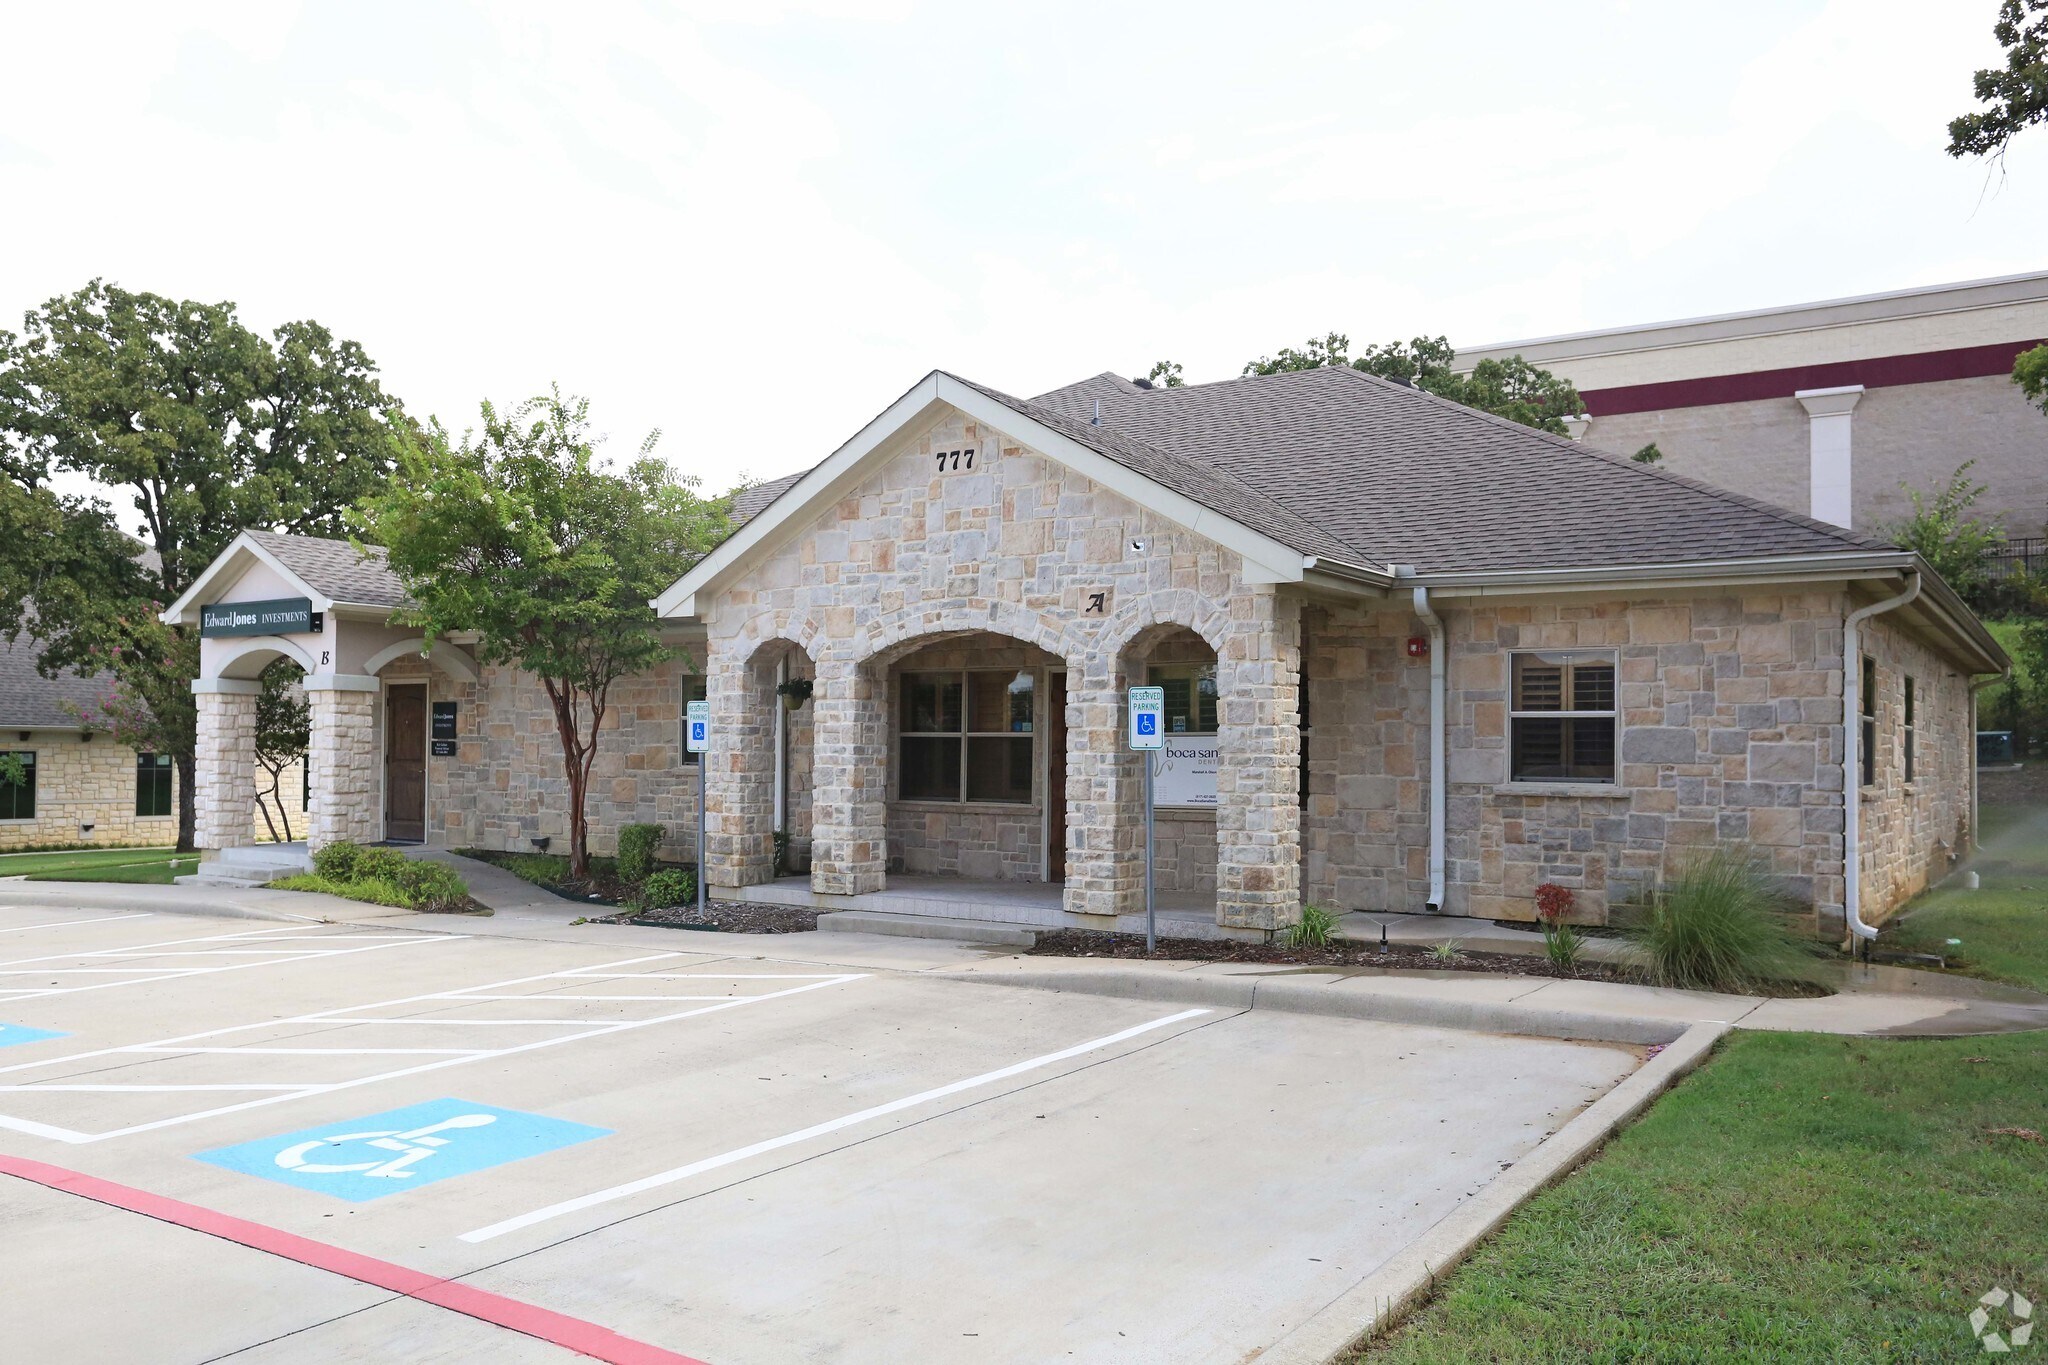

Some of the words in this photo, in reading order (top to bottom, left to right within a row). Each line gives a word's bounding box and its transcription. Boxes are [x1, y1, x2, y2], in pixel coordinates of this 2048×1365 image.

[936, 449, 975, 472] 777
[1085, 592, 1105, 613] A
[261, 610, 308, 624] INVESTMENTS
[321, 650, 330, 665] B
[1131, 692, 1161, 701] RESERVED
[1133, 702, 1160, 711] PARKING
[1166, 747, 1196, 758] boca
